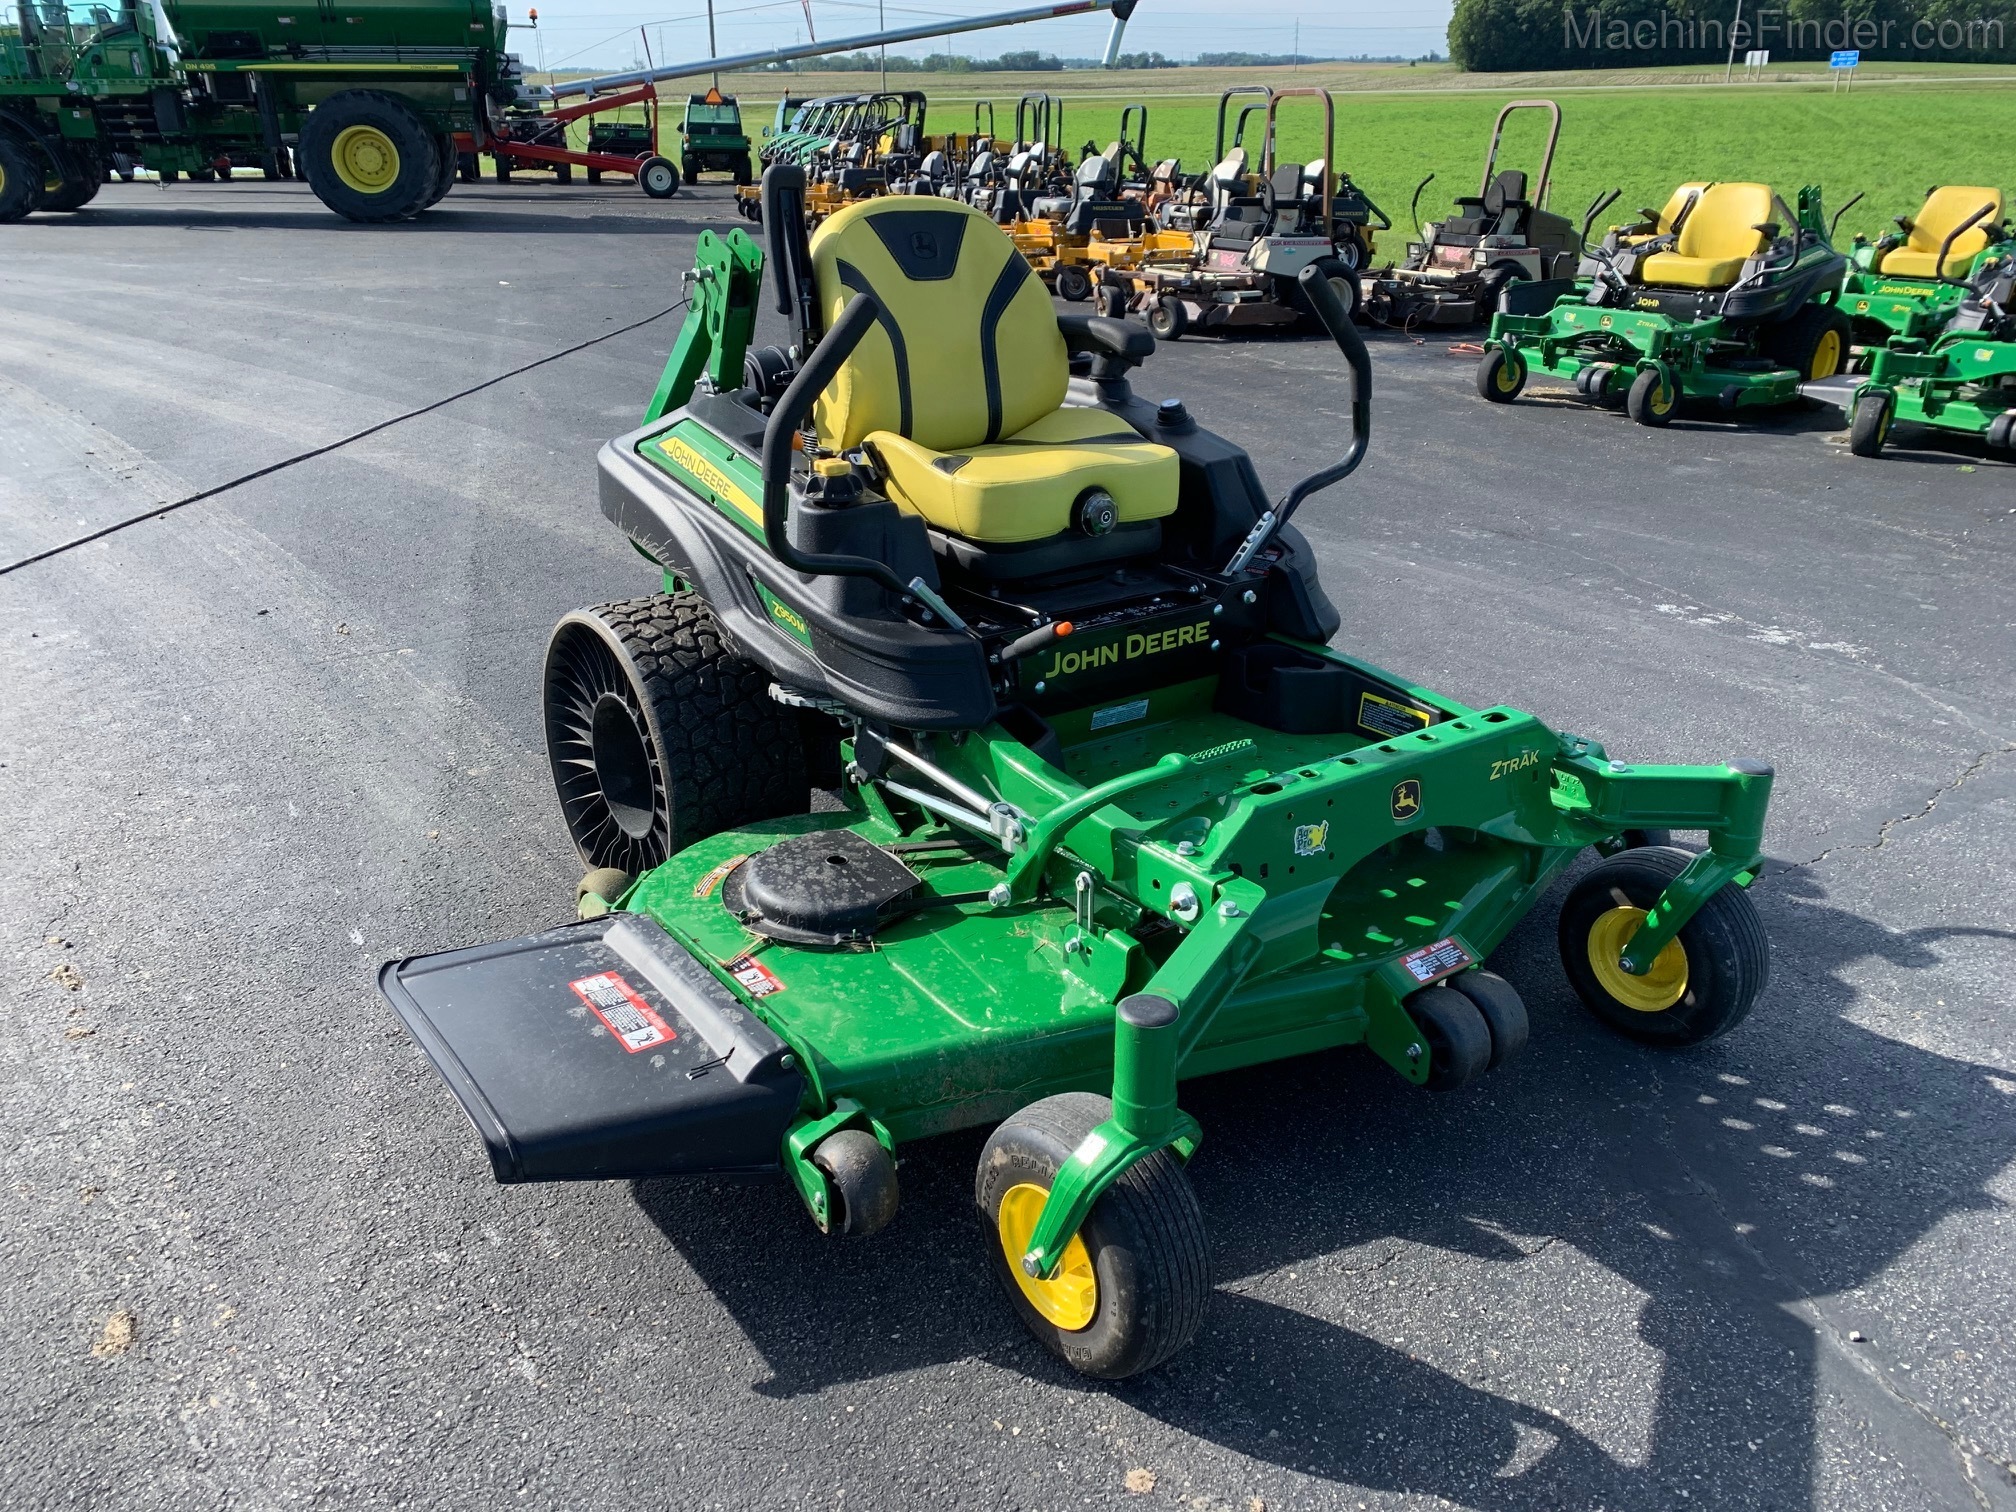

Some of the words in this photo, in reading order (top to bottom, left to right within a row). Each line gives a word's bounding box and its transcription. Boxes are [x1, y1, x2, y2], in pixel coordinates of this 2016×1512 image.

[1879, 285, 1903, 294] JOHN
[1903, 286, 1935, 296] DEERE
[669, 441, 696, 471] JOHN
[696, 460, 731, 498] DEERE
[772, 600, 806, 635] Z950M
[1046, 642, 1119, 679] JOHN
[1126, 621, 1210, 659] DEERE
[1490, 749, 1540, 781] ZTRAK
